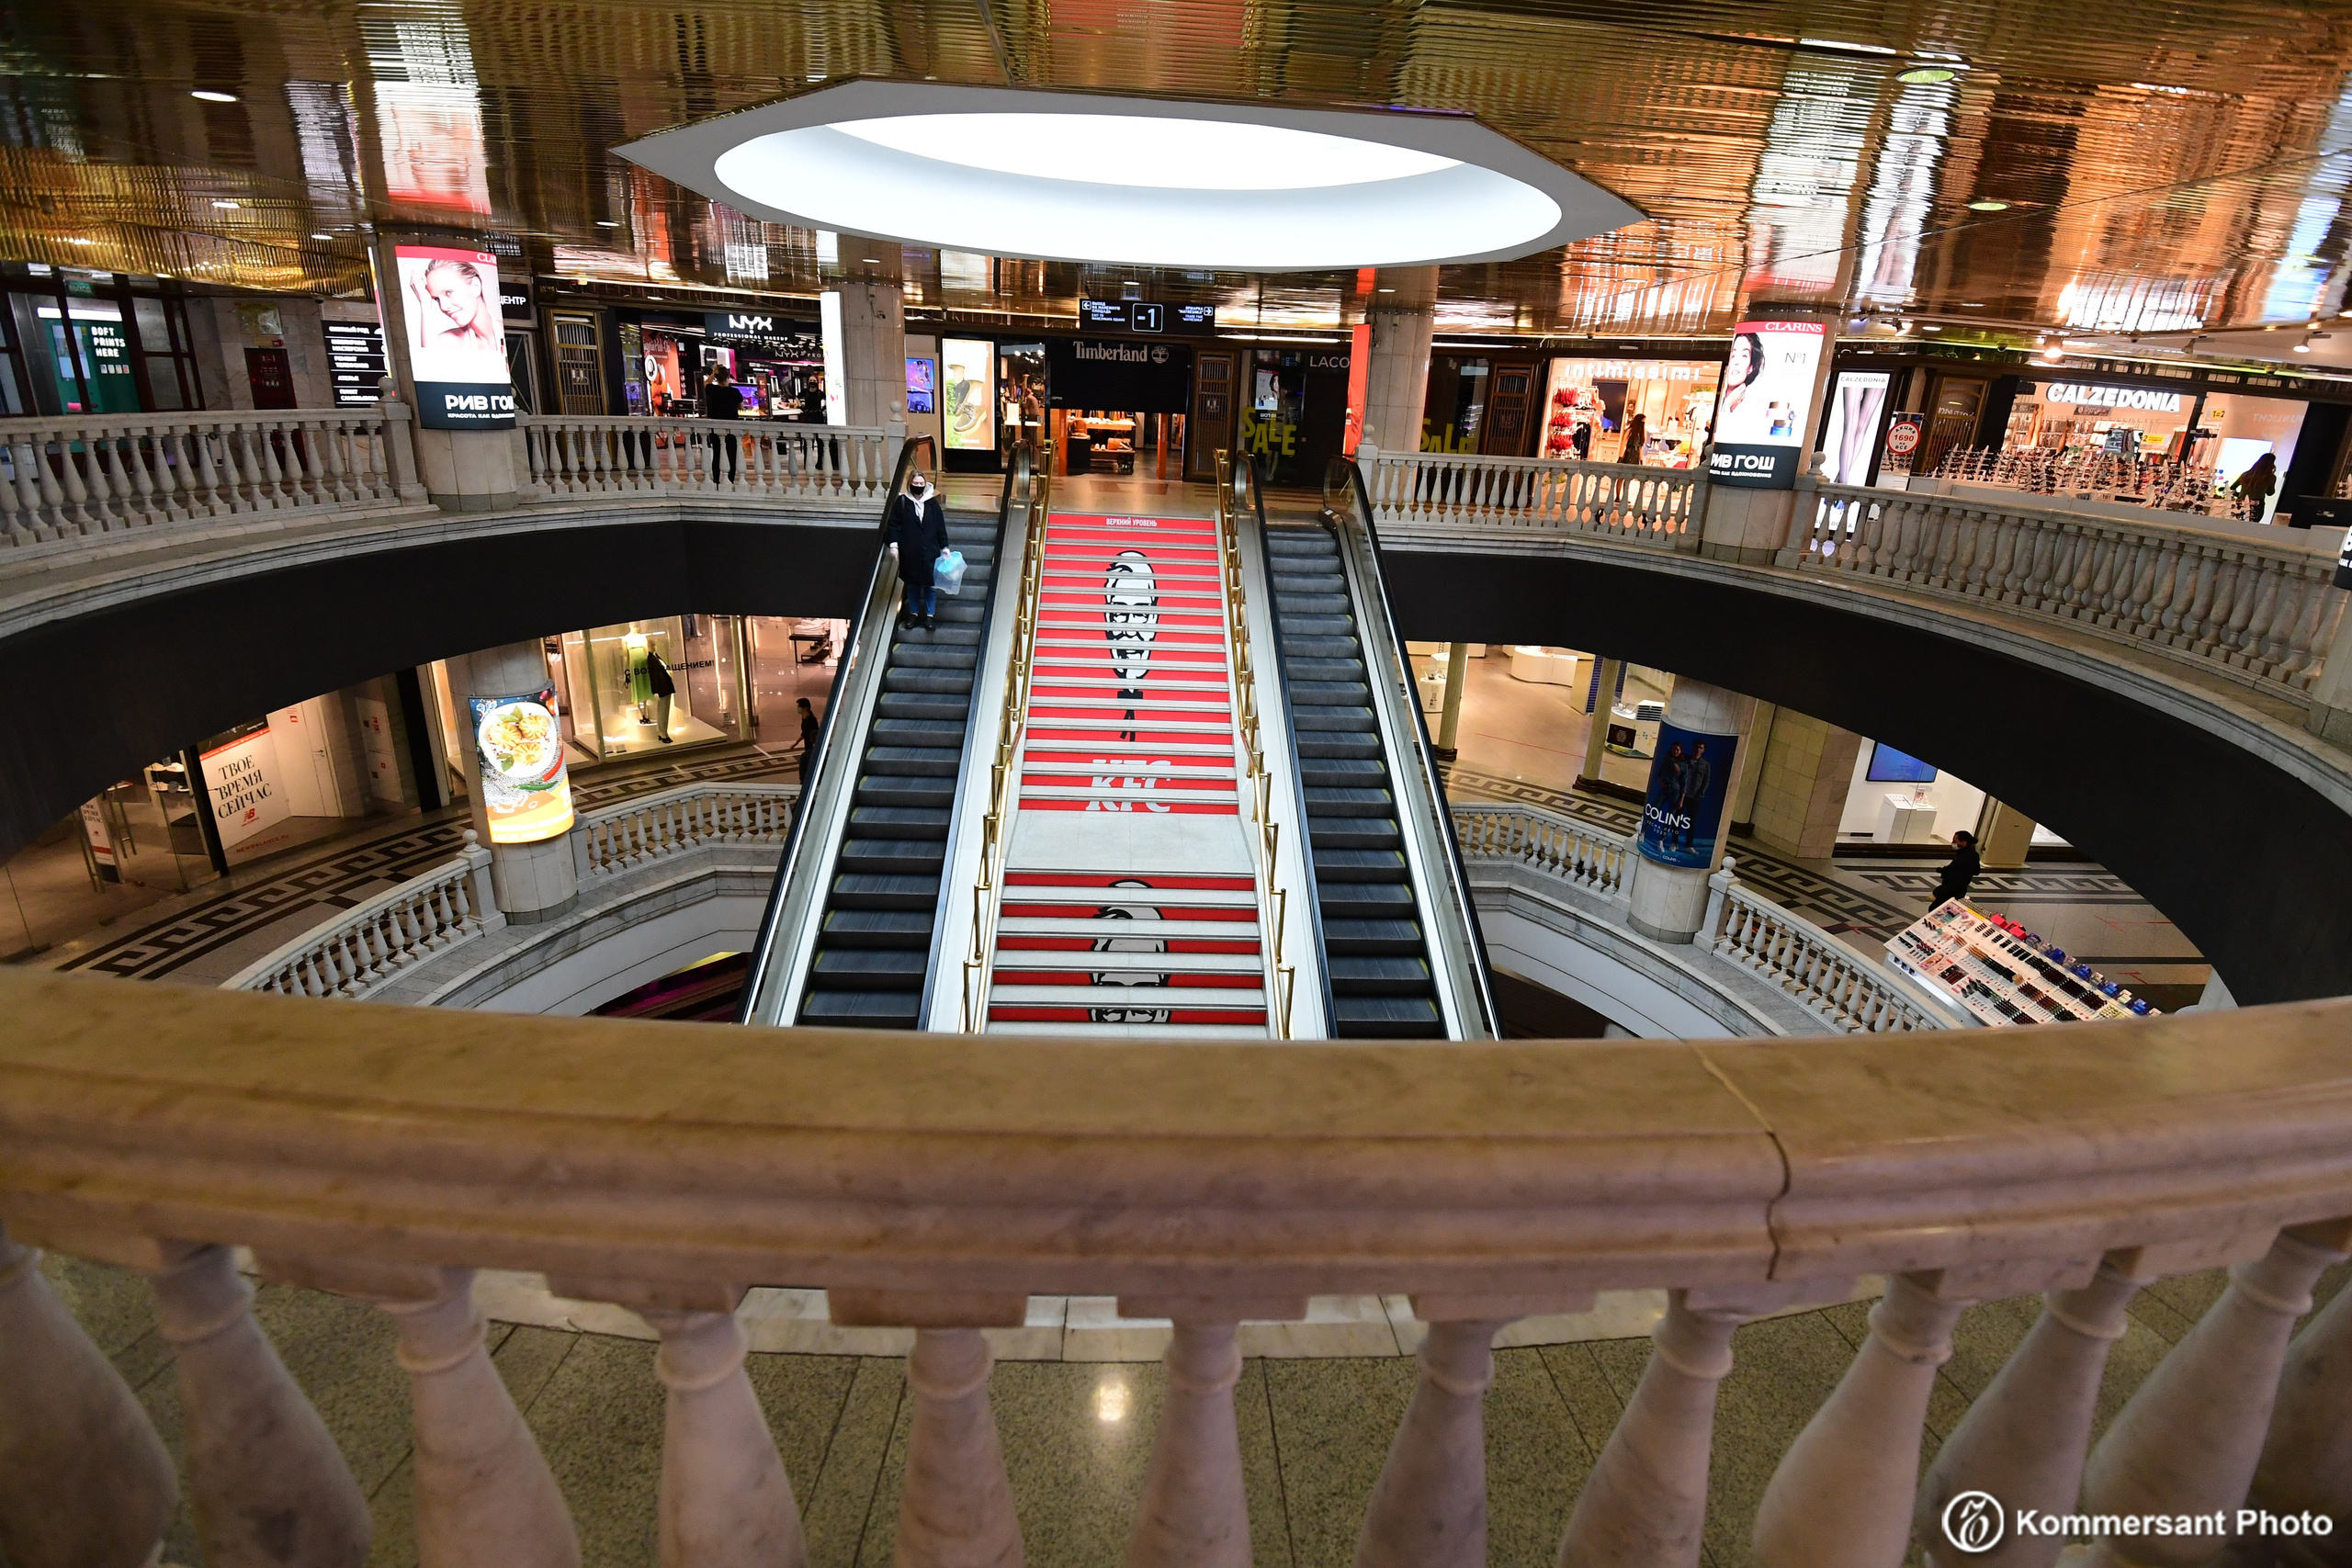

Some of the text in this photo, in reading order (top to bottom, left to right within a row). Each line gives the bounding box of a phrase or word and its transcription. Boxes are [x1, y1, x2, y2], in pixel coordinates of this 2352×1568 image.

[728, 314, 773, 333] NYX
[1137, 308, 1155, 328] -1
[91, 326, 114, 336] BOFT
[1765, 321, 1823, 333] CLARINS
[93, 337, 126, 347] PRINTS
[713, 332, 761, 340] PROFESSIONAL
[96, 348, 119, 357] HERE
[775, 350, 799, 358] NYX
[1072, 341, 1148, 367] Timberland
[445, 395, 489, 411] РИВ
[2046, 382, 2180, 412] CALZEDONIA
[1240, 406, 1296, 456] SALE
[1895, 425, 1917, 434] АКЦИЯ
[1894, 434, 1915, 442] 1690
[1734, 455, 1775, 470] ГОШ
[1106, 517, 1158, 527] ВЕРХНИЙ УРОВЕНЬ
[219, 755, 254, 780] ТВОЕ
[219, 770, 263, 800] ВРЕМЯ
[1085, 759, 1172, 813] KFC
[218, 783, 272, 819] СЕЙЧАС
[1645, 803, 1691, 829] COLIN'S
